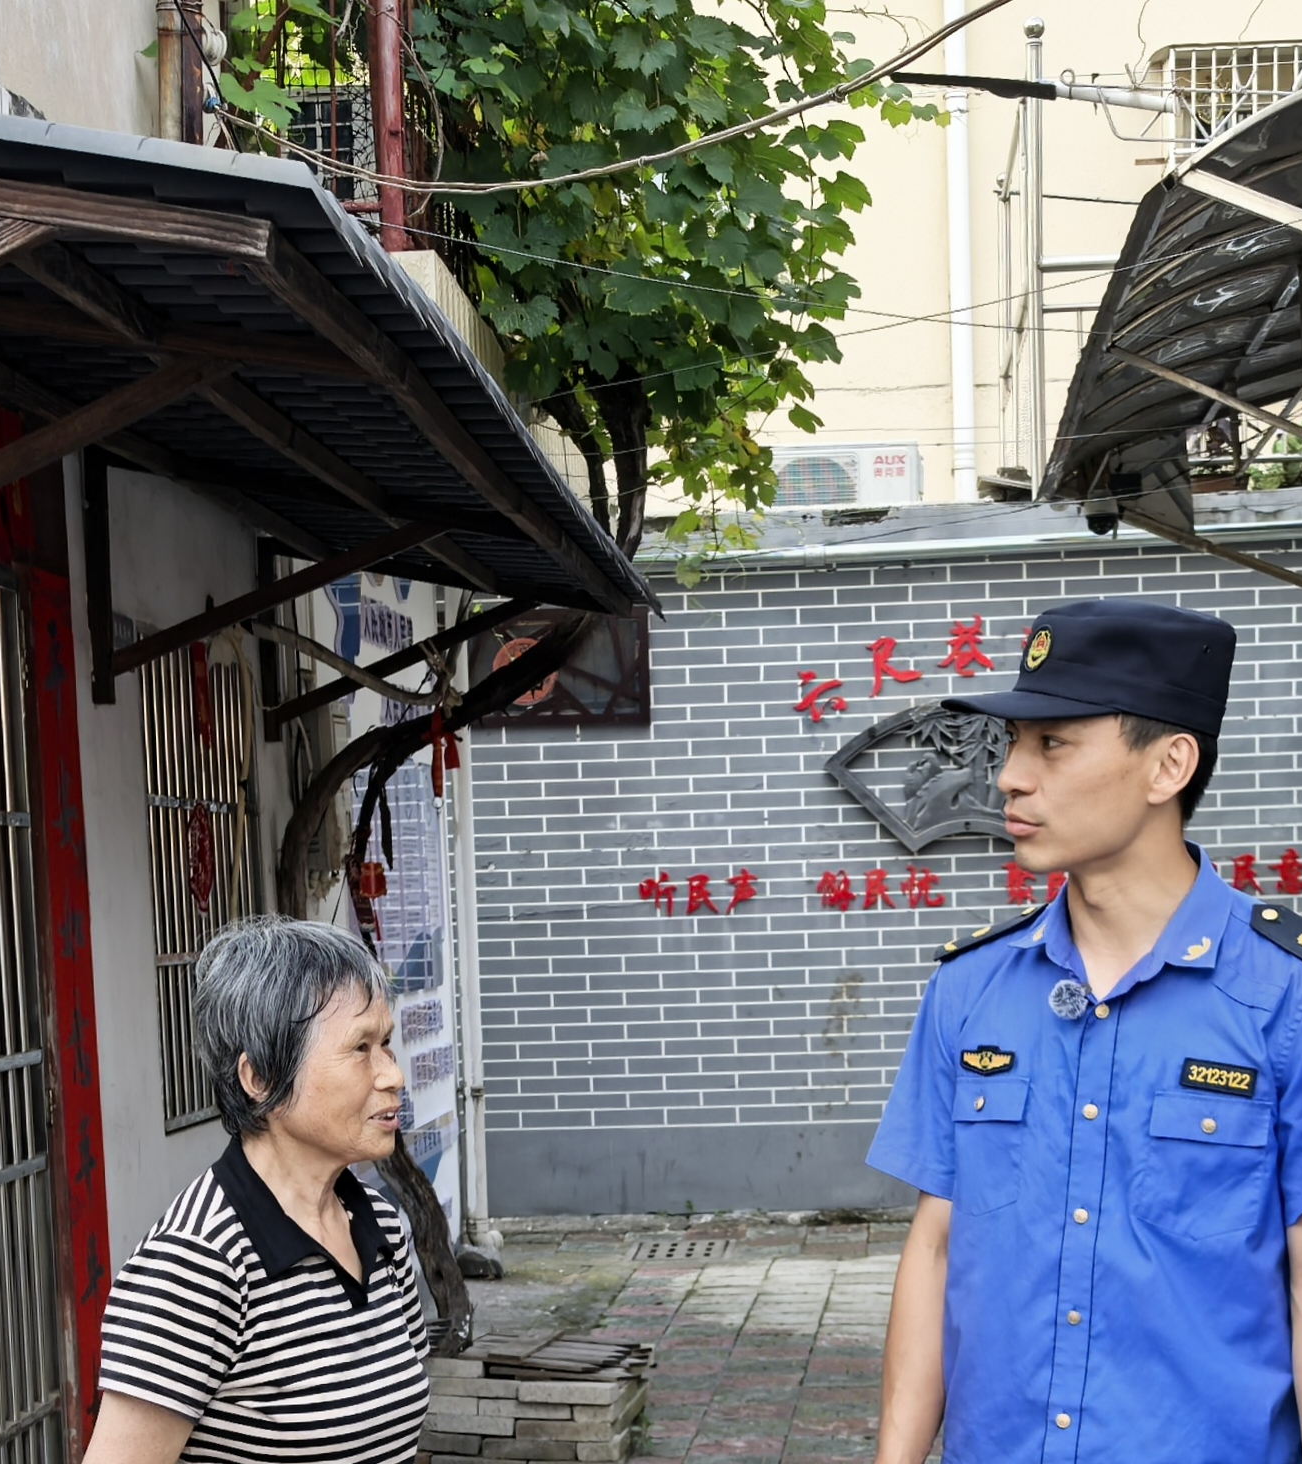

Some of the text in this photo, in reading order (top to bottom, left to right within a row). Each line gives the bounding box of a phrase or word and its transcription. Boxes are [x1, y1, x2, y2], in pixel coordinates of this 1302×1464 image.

[873, 455, 906, 465] AUX
[873, 467, 906, 478] 奥克斯
[793, 613, 1033, 723] 六尺巷
[638, 867, 759, 918] 听民声
[1001, 861, 1068, 905] 聚民
[1187, 1064, 1251, 1091] 32123122
